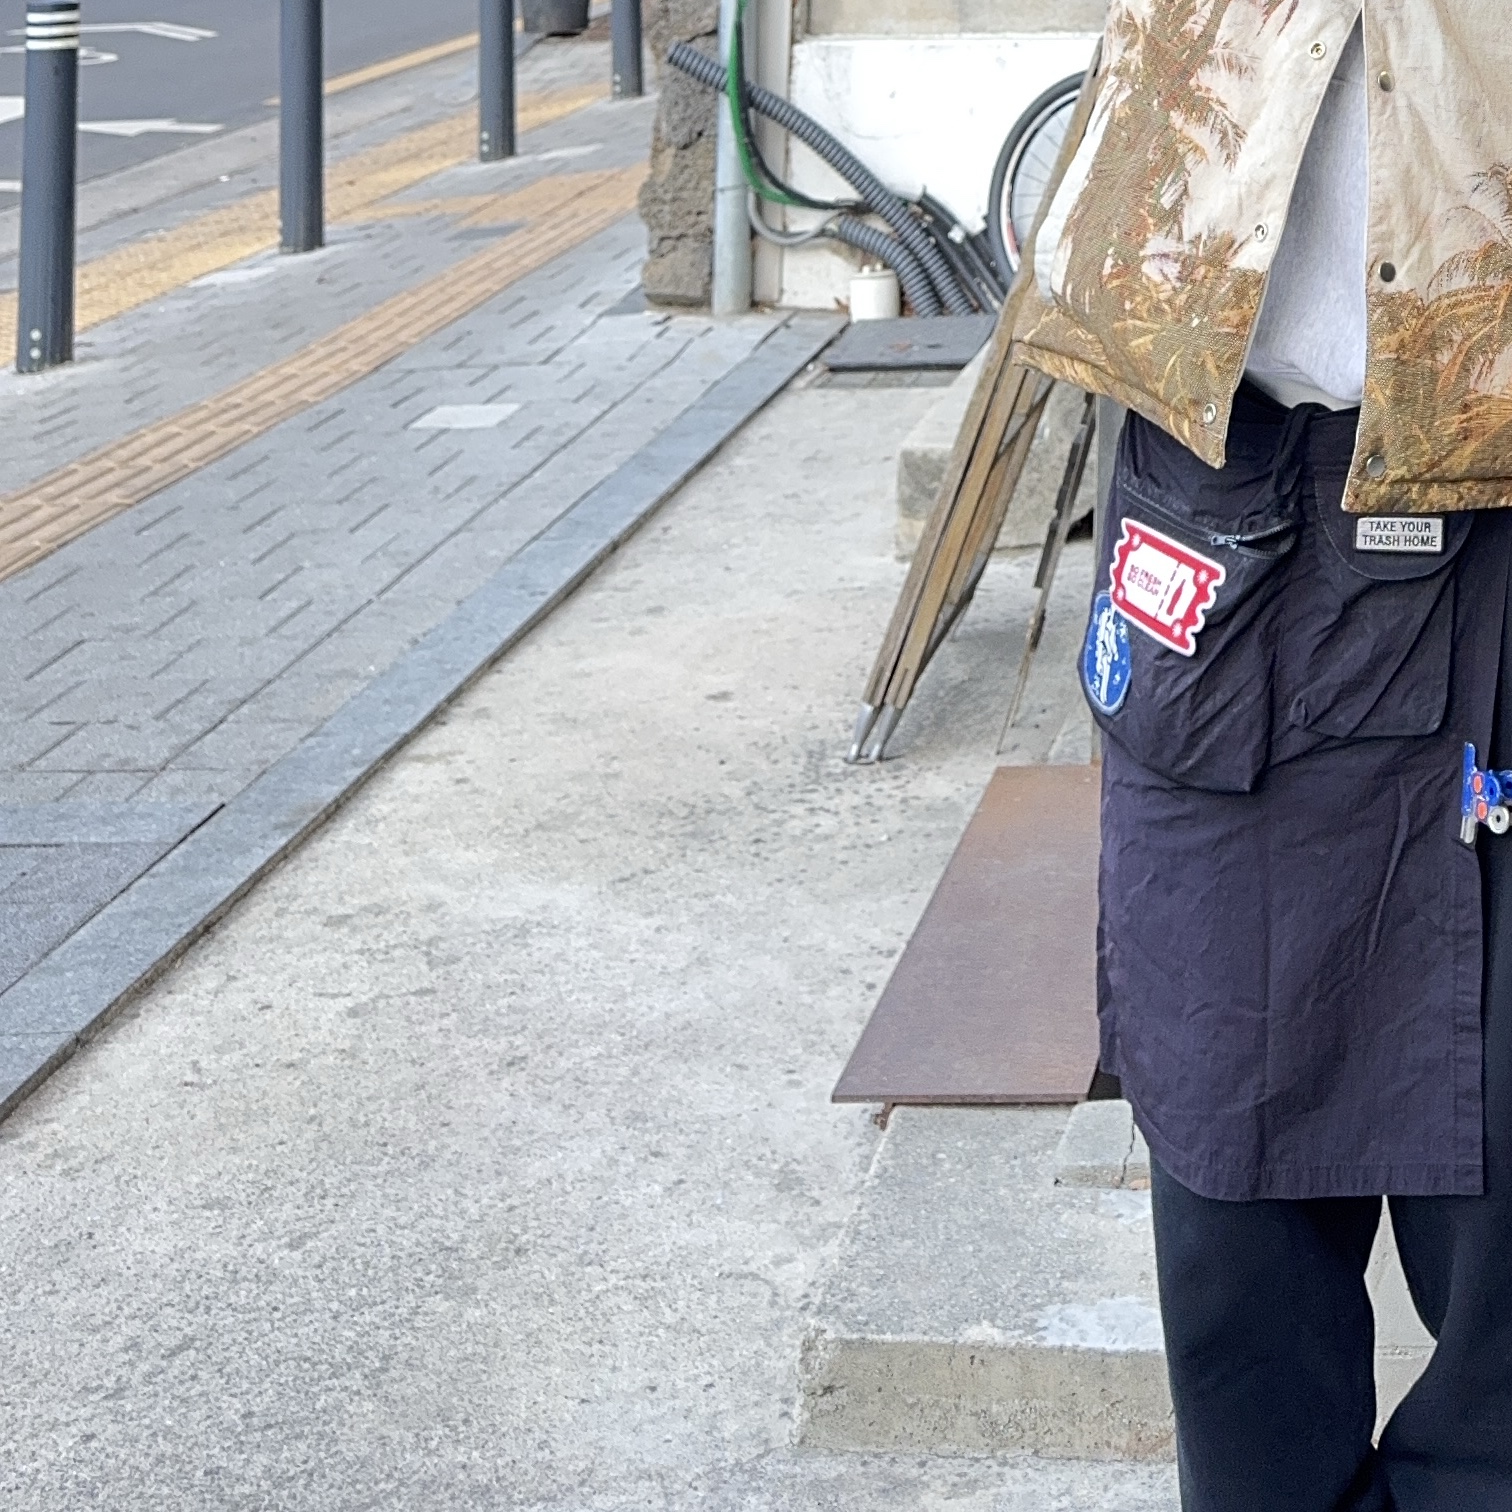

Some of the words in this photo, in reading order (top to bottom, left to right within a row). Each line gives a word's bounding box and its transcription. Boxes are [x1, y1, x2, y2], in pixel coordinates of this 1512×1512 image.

[1369, 521, 1397, 532] TAKE
[1400, 521, 1431, 533] YOUR
[1362, 534, 1400, 546] TRASH
[1404, 536, 1437, 547] HOME
[1140, 569, 1162, 585] FRESH
[1137, 578, 1159, 596] CLEAN
